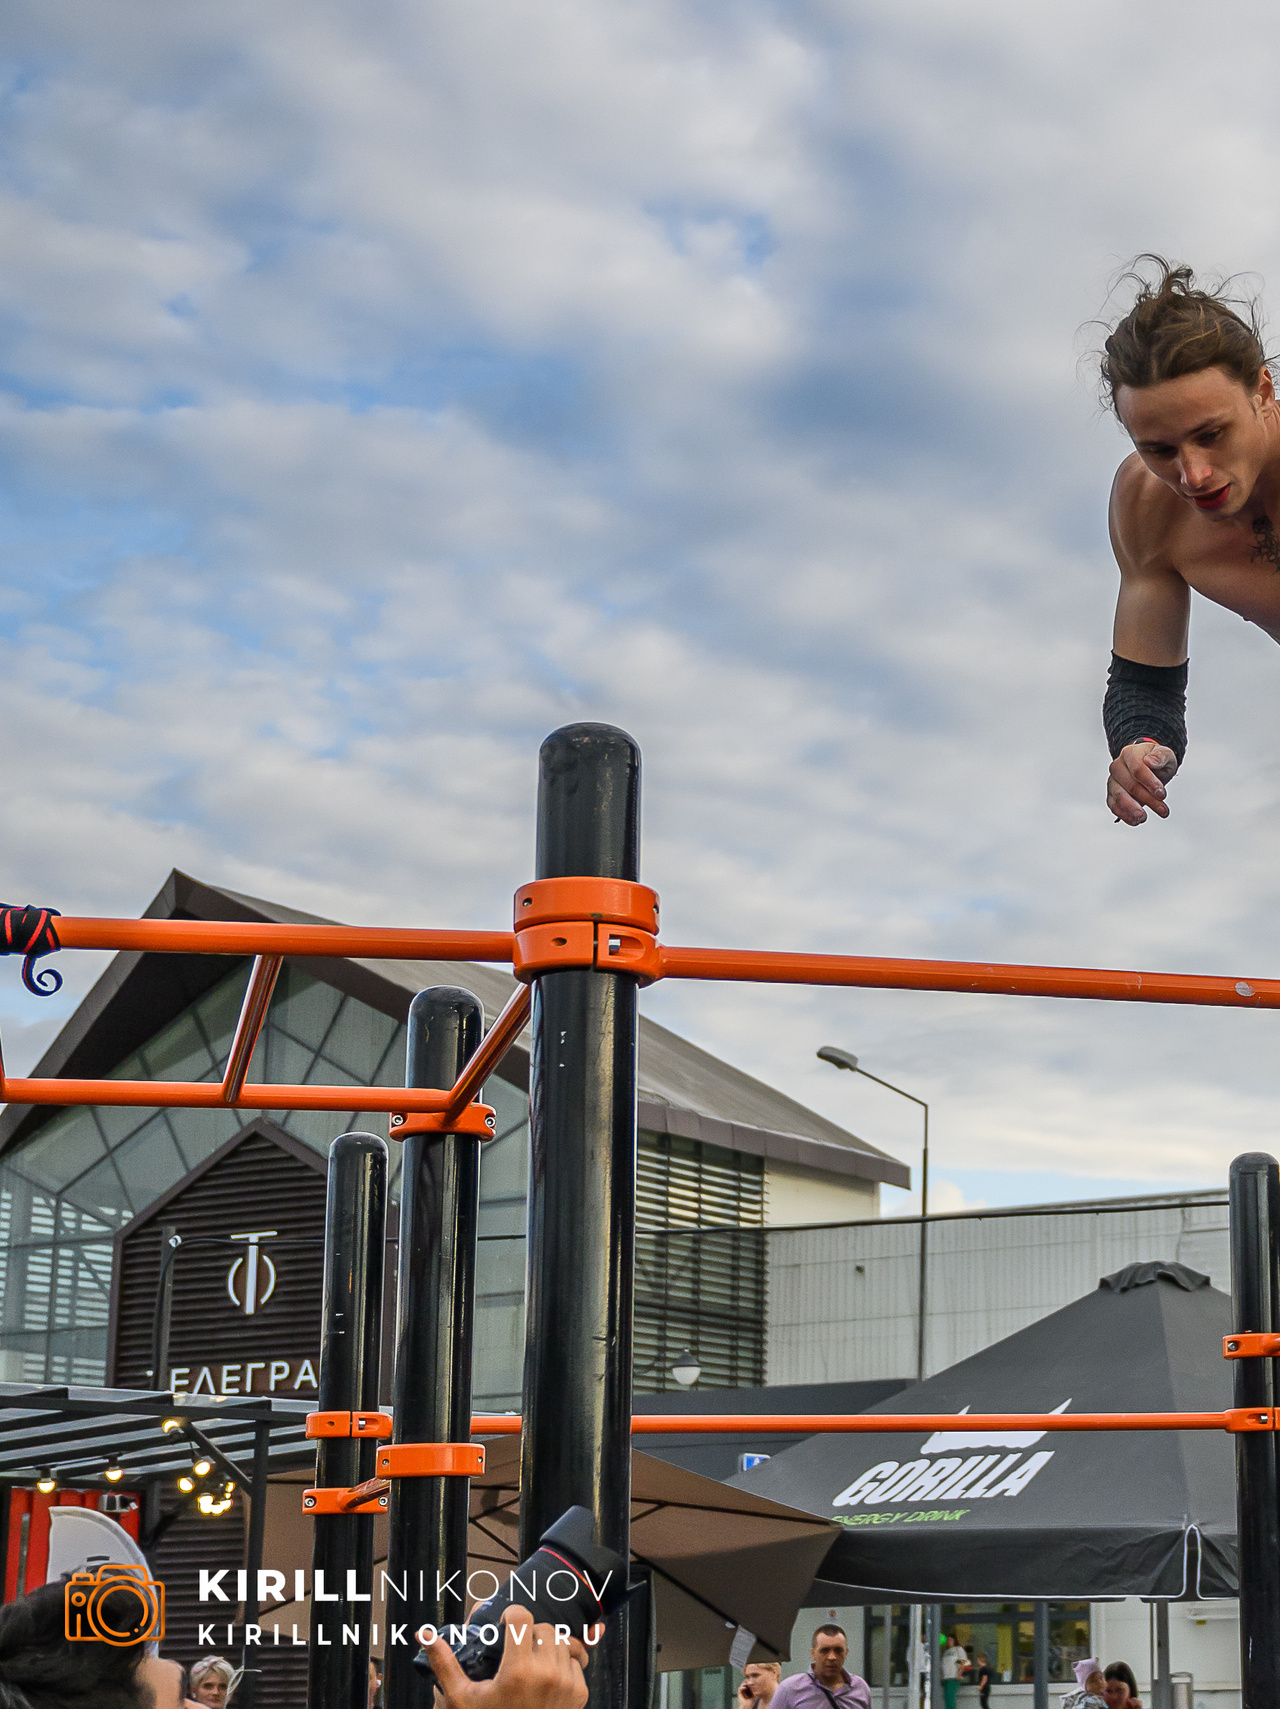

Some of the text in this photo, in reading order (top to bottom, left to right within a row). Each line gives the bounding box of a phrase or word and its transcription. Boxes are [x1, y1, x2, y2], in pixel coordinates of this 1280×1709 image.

[146, 1359, 318, 1395] ЕЛЕГРА
[832, 1450, 1055, 1506] GORILLA
[903, 1509, 971, 1523] DRINK
